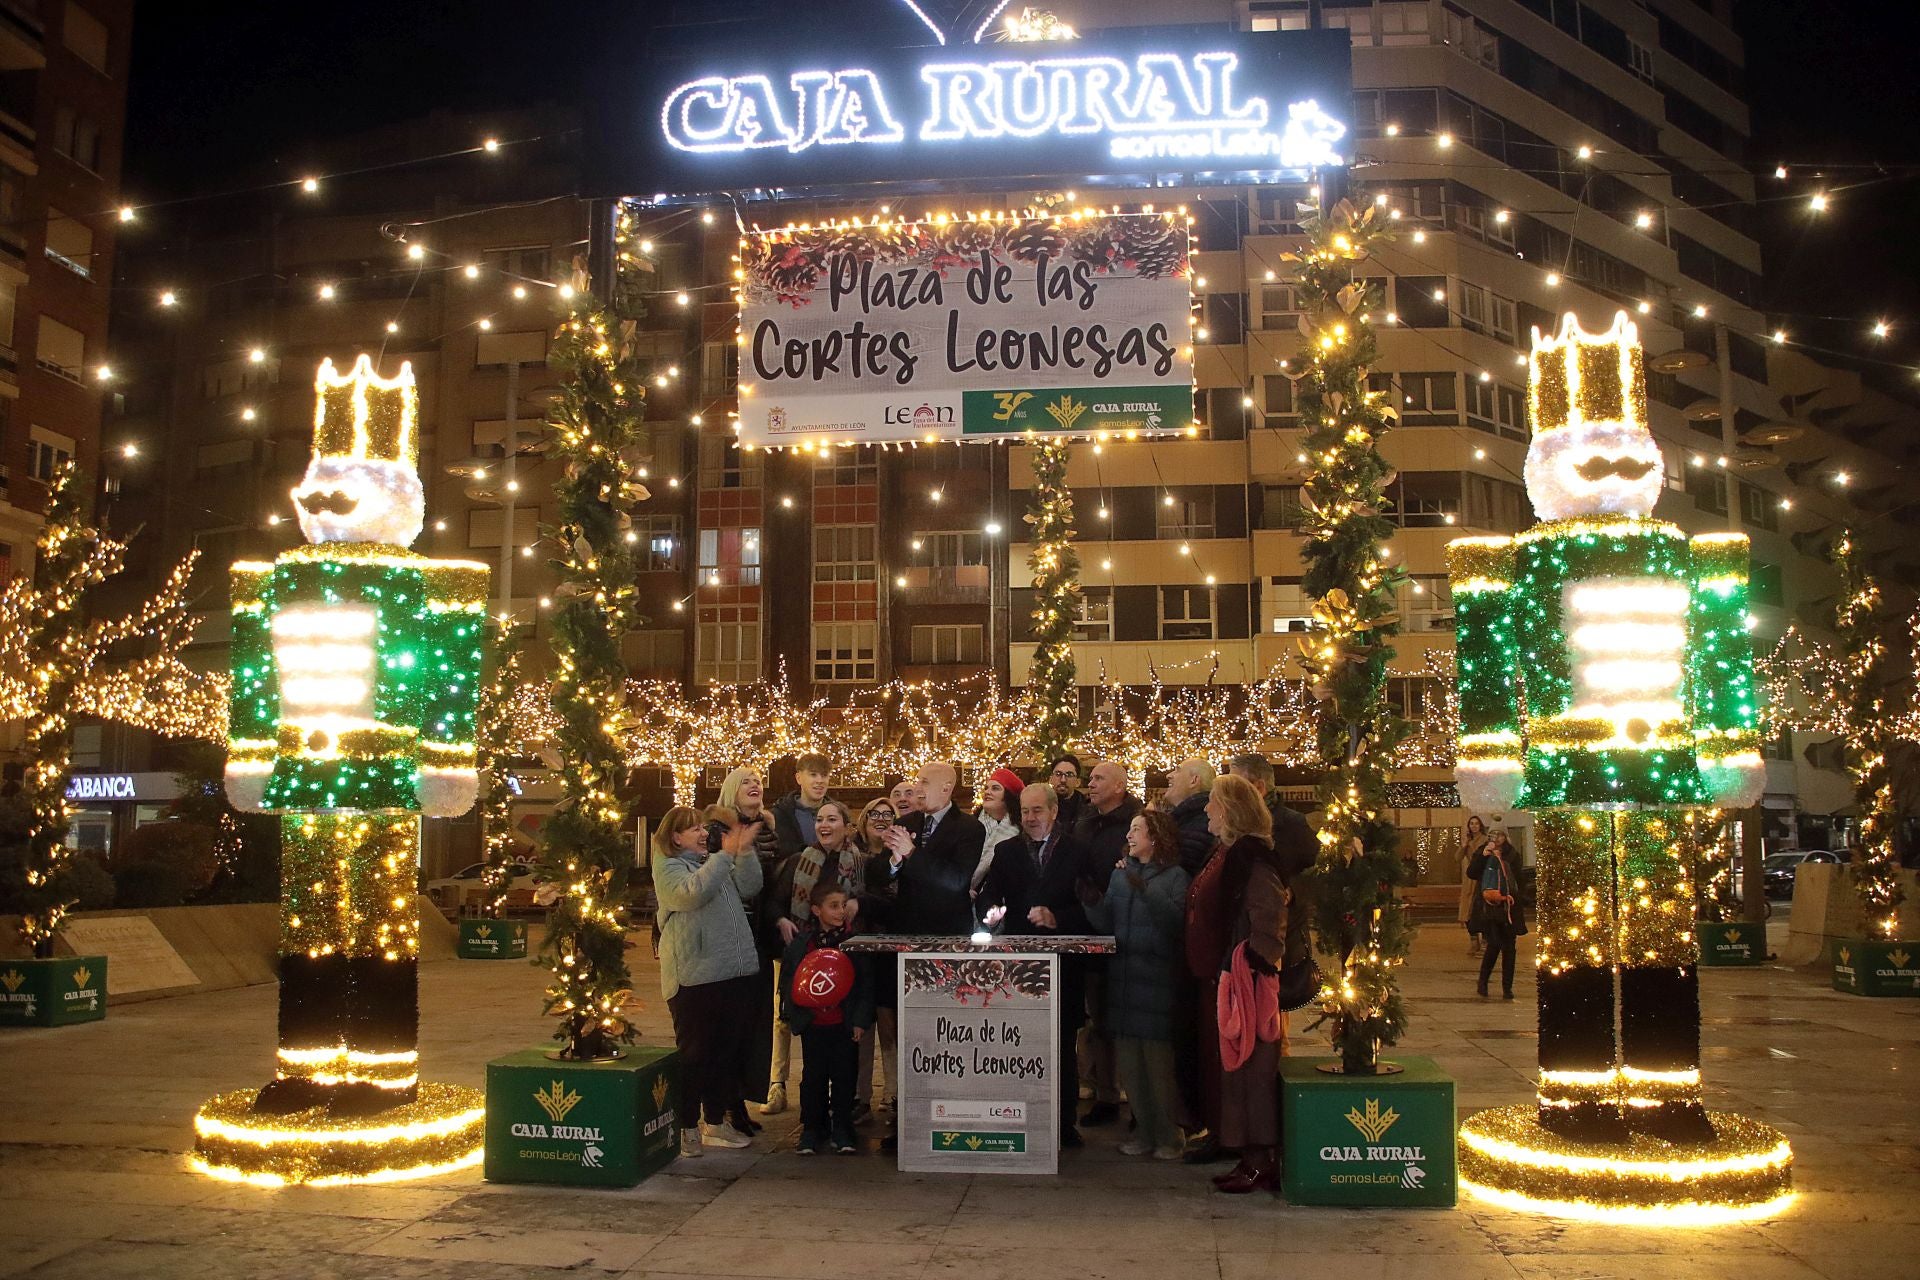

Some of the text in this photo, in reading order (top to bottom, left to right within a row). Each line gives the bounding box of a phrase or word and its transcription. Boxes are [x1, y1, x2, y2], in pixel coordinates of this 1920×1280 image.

[662, 52, 1268, 153] CAJA RURAL
[829, 249, 1098, 313] Plaza de las
[752, 309, 1177, 385] Cortes Leonesas
[1092, 403, 1162, 413] CAJA RURAL
[791, 423, 839, 431] AYUNTAMIENTO
[72, 777, 135, 798] ABANCA
[936, 1016, 1021, 1046] Plaza de las
[912, 1047, 1045, 1079] Cortes Leonesas
[511, 1123, 605, 1141] CAJA RURAL
[1319, 1146, 1426, 1162] CAJA RURAL
